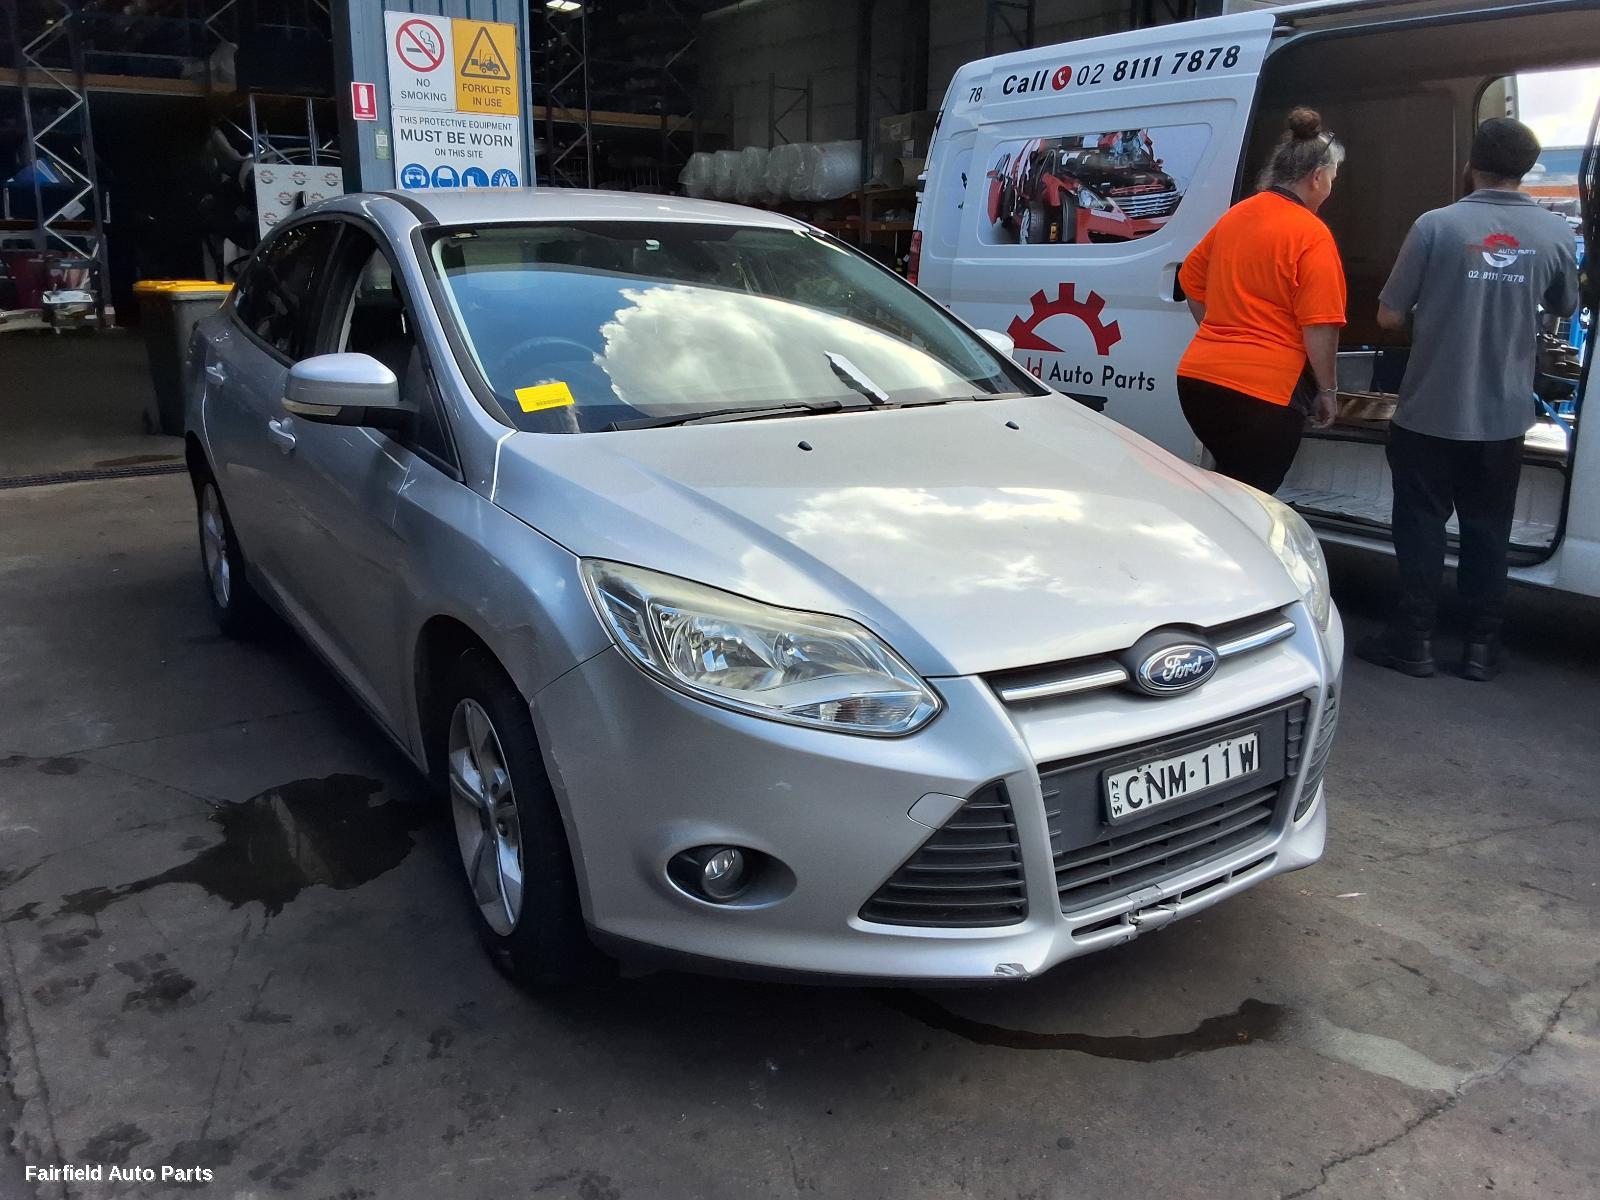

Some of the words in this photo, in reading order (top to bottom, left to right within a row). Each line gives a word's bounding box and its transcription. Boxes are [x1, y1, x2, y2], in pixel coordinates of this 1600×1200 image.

[1003, 69, 1049, 95] Call
[1077, 63, 1105, 86] 02
[1113, 55, 1163, 82] 8111
[1171, 45, 1241, 75] 7878
[416, 78, 431, 87] NO
[462, 83, 511, 95] FORKLIFTS
[401, 90, 447, 102] SMOKING
[473, 97, 482, 106] IN
[484, 98, 502, 107] USE
[968, 86, 983, 104] 78
[399, 116, 418, 124] THIS
[420, 117, 467, 128] PROTECTIVE
[469, 120, 513, 131] EQUIPMENT
[400, 128, 442, 143] MUST
[447, 131, 465, 145] BE
[470, 132, 513, 148] WORN
[435, 148, 446, 156] ON
[448, 149, 465, 158] THIS
[467, 150, 484, 159] SITE
[1468, 270, 1479, 279] 02
[1482, 271, 1499, 280] 8111
[1502, 273, 1525, 283] 7878
[1049, 360, 1094, 385] Auto
[1101, 364, 1155, 392] Parts
[1162, 652, 1204, 682] Ford
